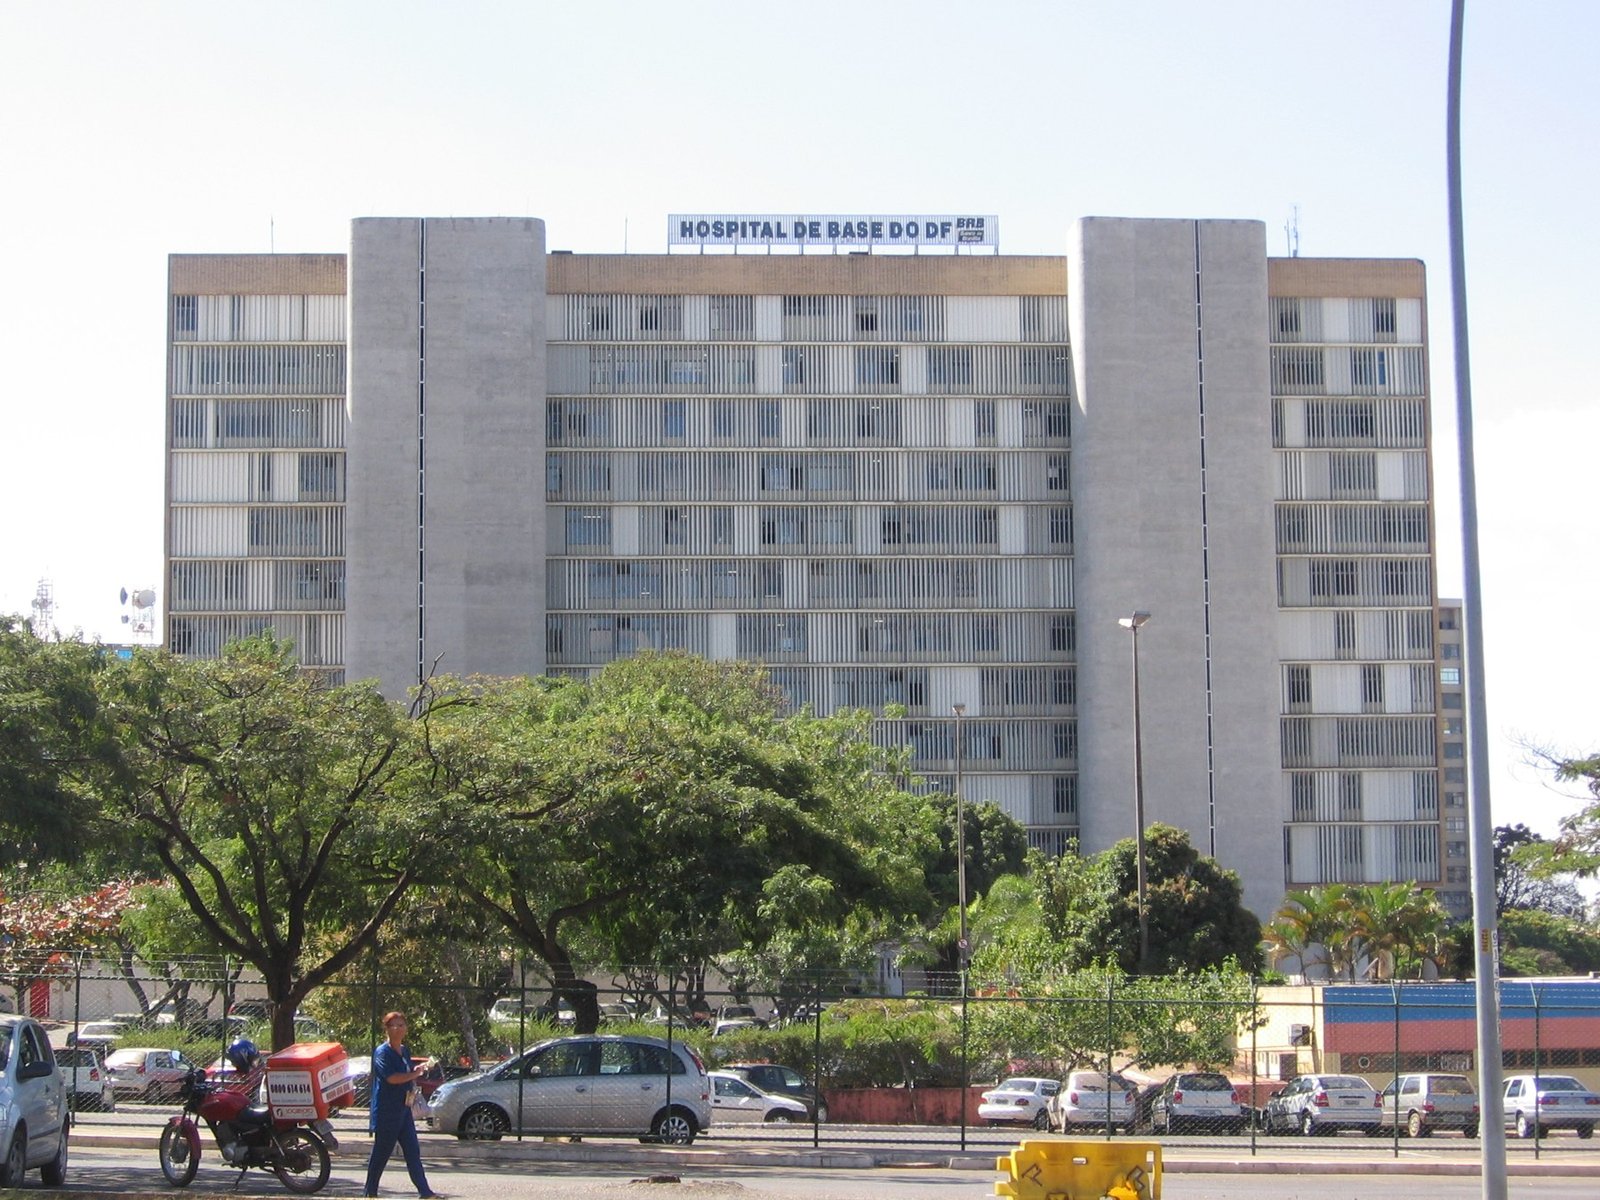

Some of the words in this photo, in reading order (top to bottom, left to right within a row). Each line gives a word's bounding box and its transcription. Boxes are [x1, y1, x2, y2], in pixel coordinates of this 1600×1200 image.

[680, 220, 787, 238] HOSPITAL
[794, 221, 821, 238] DE
[828, 221, 882, 238] BASE
[889, 221, 919, 238] DO
[925, 222, 952, 238] DF
